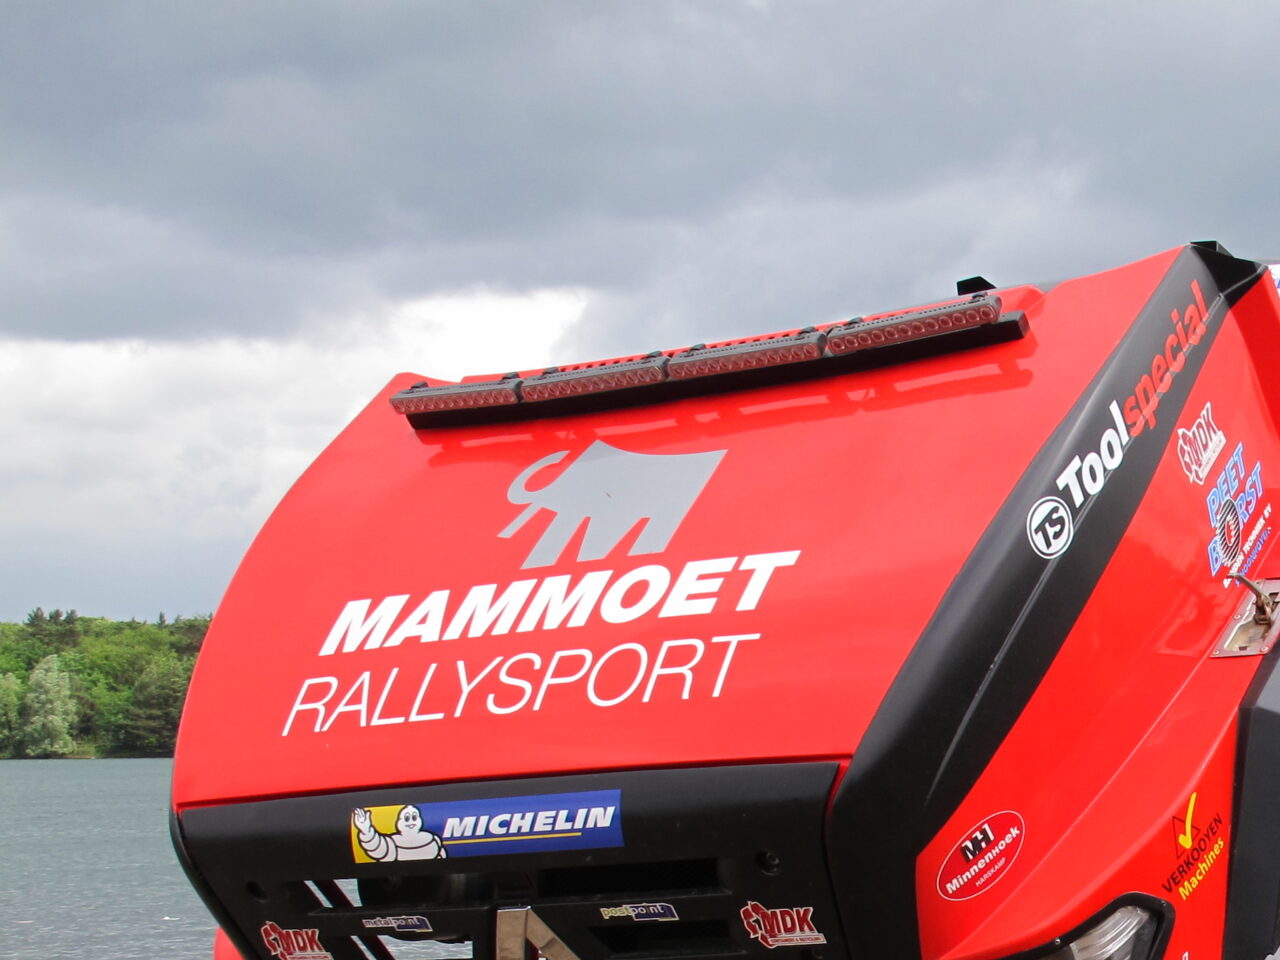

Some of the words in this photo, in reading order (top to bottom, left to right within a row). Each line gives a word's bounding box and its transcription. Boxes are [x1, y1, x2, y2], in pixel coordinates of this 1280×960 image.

[1184, 402, 1219, 469] MDK
[1207, 442, 1245, 528] PEET
[1034, 505, 1067, 551] TS
[319, 550, 801, 656] MAMMOET
[282, 633, 760, 736] RALLYSPORT
[443, 806, 616, 839] MICHELIN
[975, 856, 1007, 887] HARSKAMP
[1161, 812, 1223, 894] VERKOOYEN
[1178, 836, 1224, 901] Machines
[602, 903, 665, 918] postpoint
[761, 907, 816, 937] MDK
[281, 928, 324, 954] MDK
